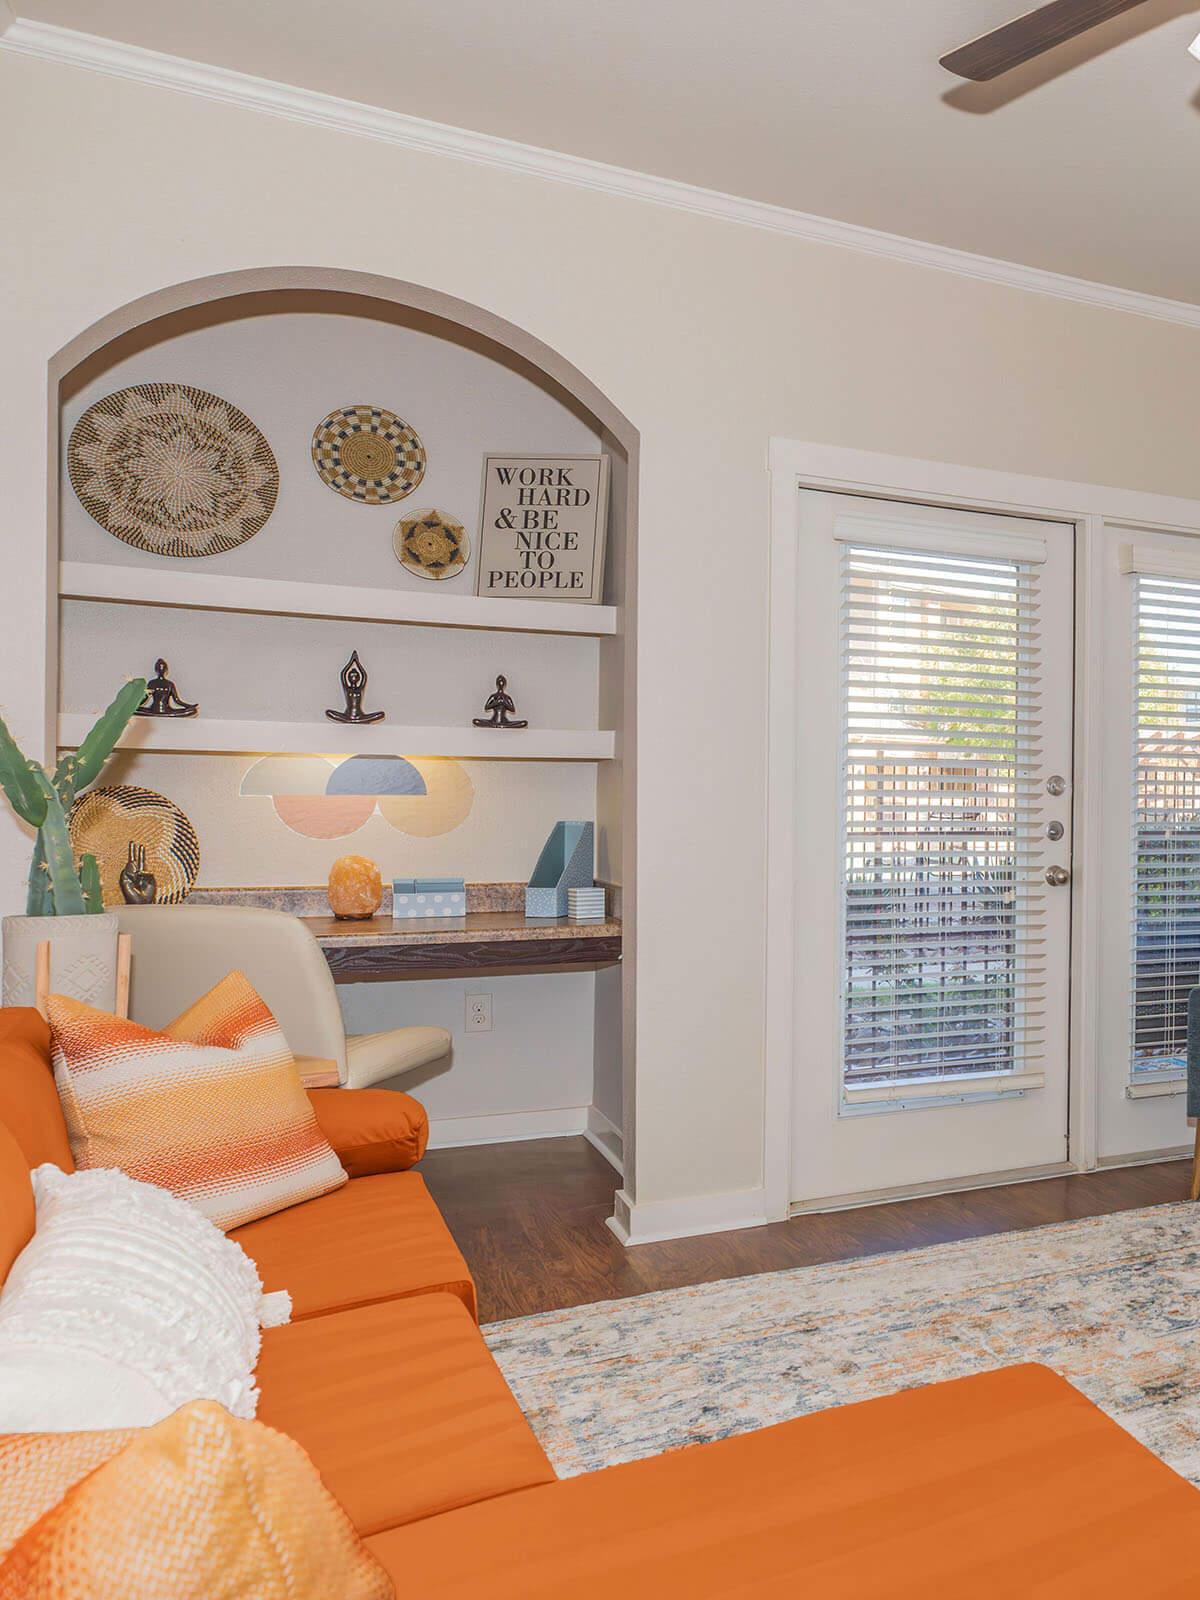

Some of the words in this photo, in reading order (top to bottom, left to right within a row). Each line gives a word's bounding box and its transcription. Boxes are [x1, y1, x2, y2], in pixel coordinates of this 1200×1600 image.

[495, 467, 574, 487] WORK
[517, 487, 591, 507] HARD
[514, 531, 579, 551] NICE
[519, 550, 555, 570] TO
[487, 570, 584, 589] PEOPLE
